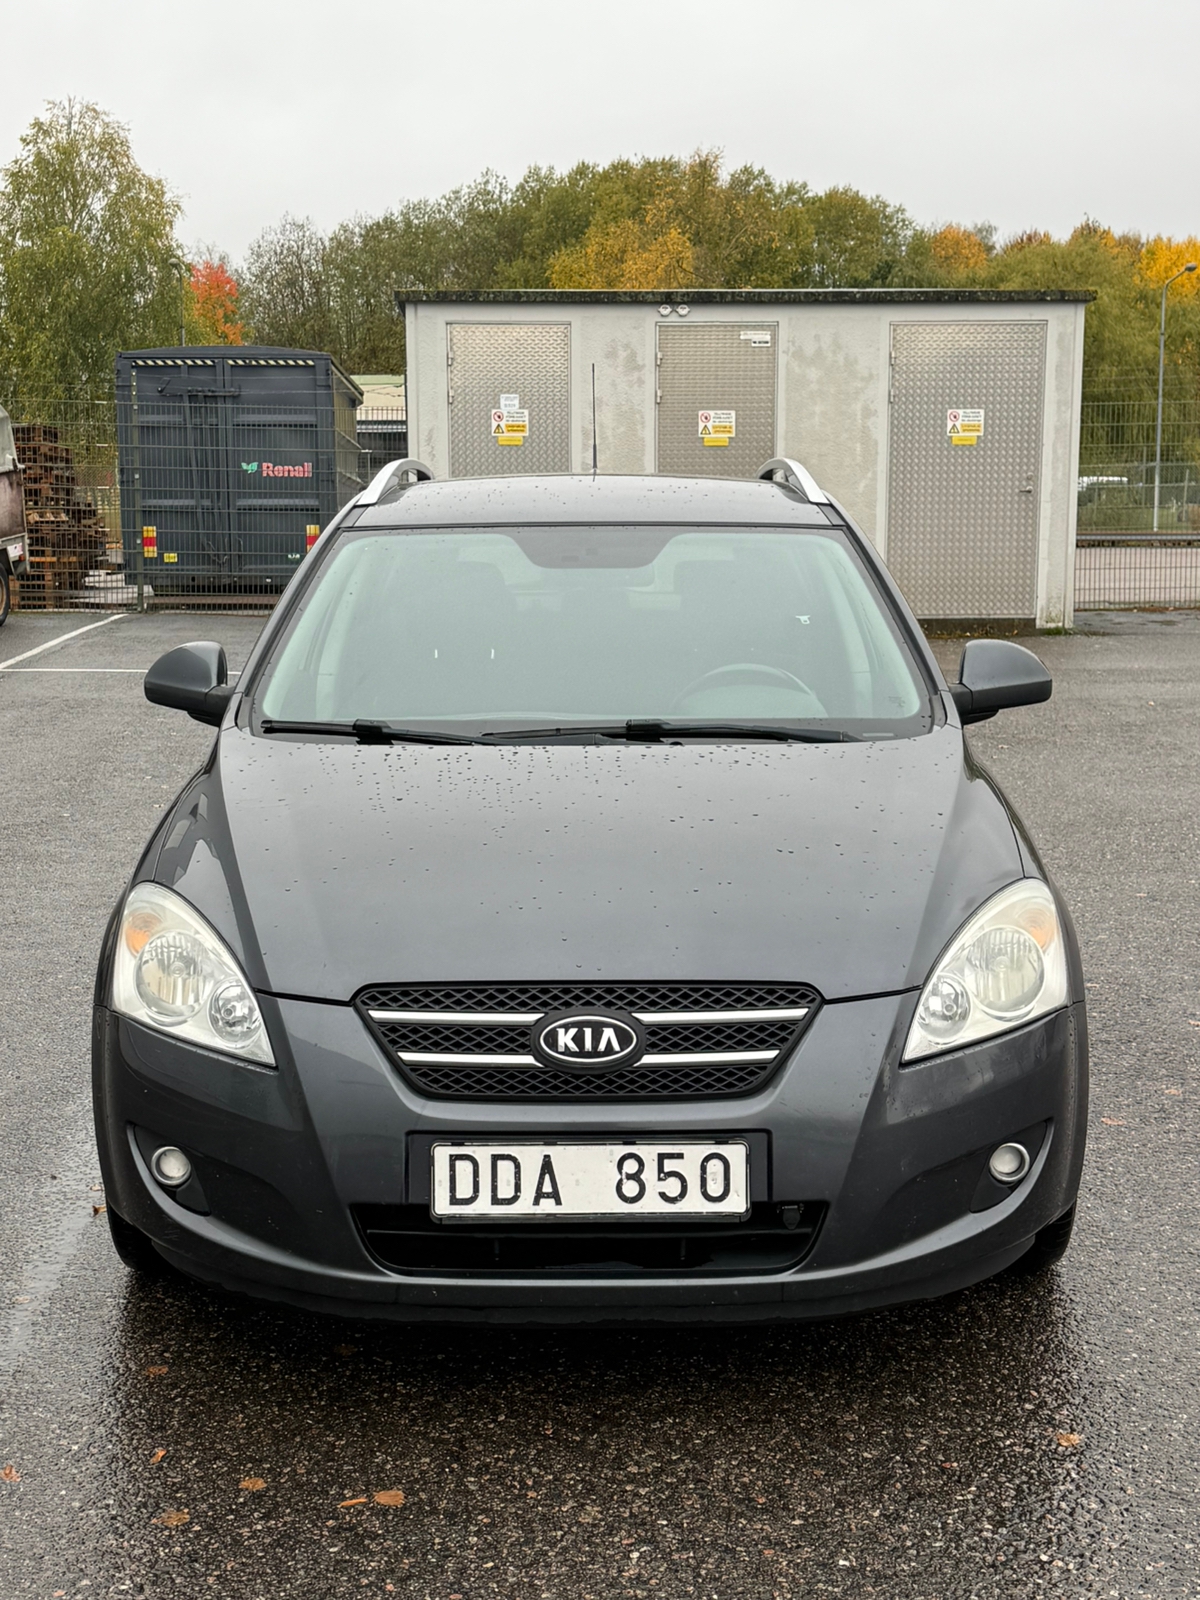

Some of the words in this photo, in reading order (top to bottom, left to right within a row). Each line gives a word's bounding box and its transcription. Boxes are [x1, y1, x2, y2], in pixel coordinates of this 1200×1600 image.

[556, 1028, 621, 1052] KIA
[449, 1153, 563, 1206] DDA
[615, 1152, 731, 1204] 850
